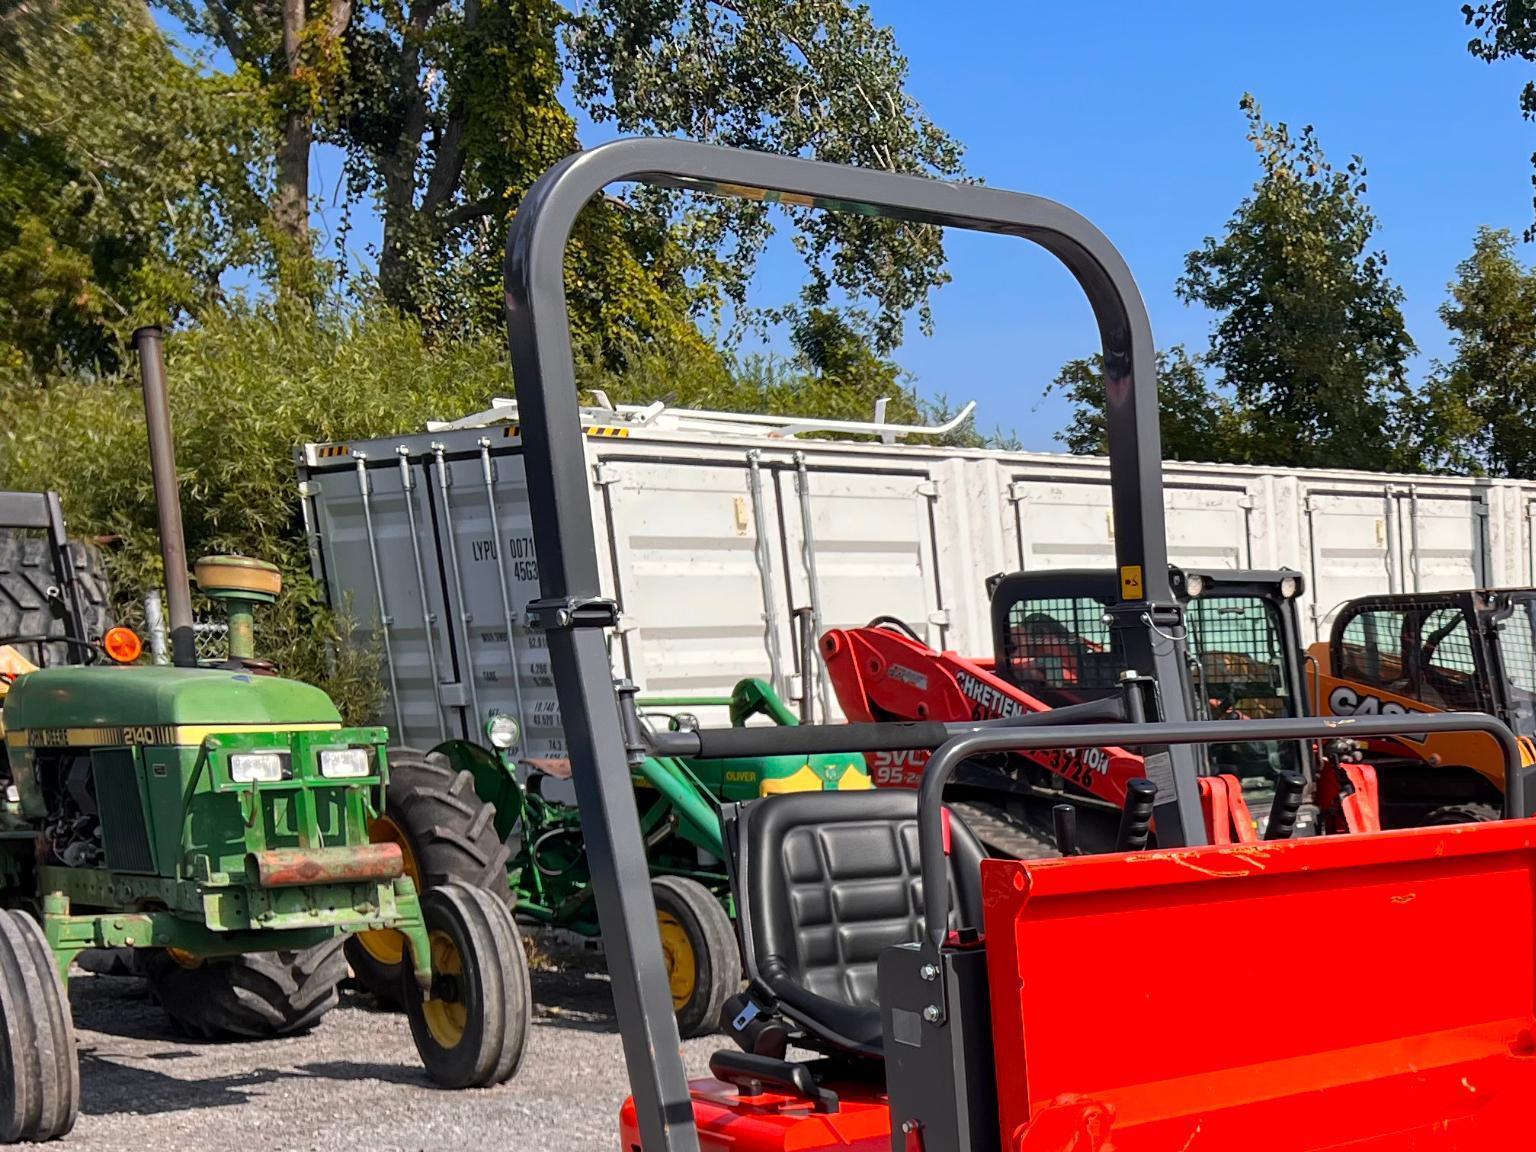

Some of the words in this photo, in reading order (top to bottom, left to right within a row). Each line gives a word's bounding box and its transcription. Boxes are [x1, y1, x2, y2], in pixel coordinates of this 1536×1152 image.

[472, 540, 497, 561] LYPU
[509, 538, 535, 559] 0071
[514, 561, 539, 580] 45G3
[124, 727, 154, 745] 2140
[726, 771, 756, 782] OLIVER
